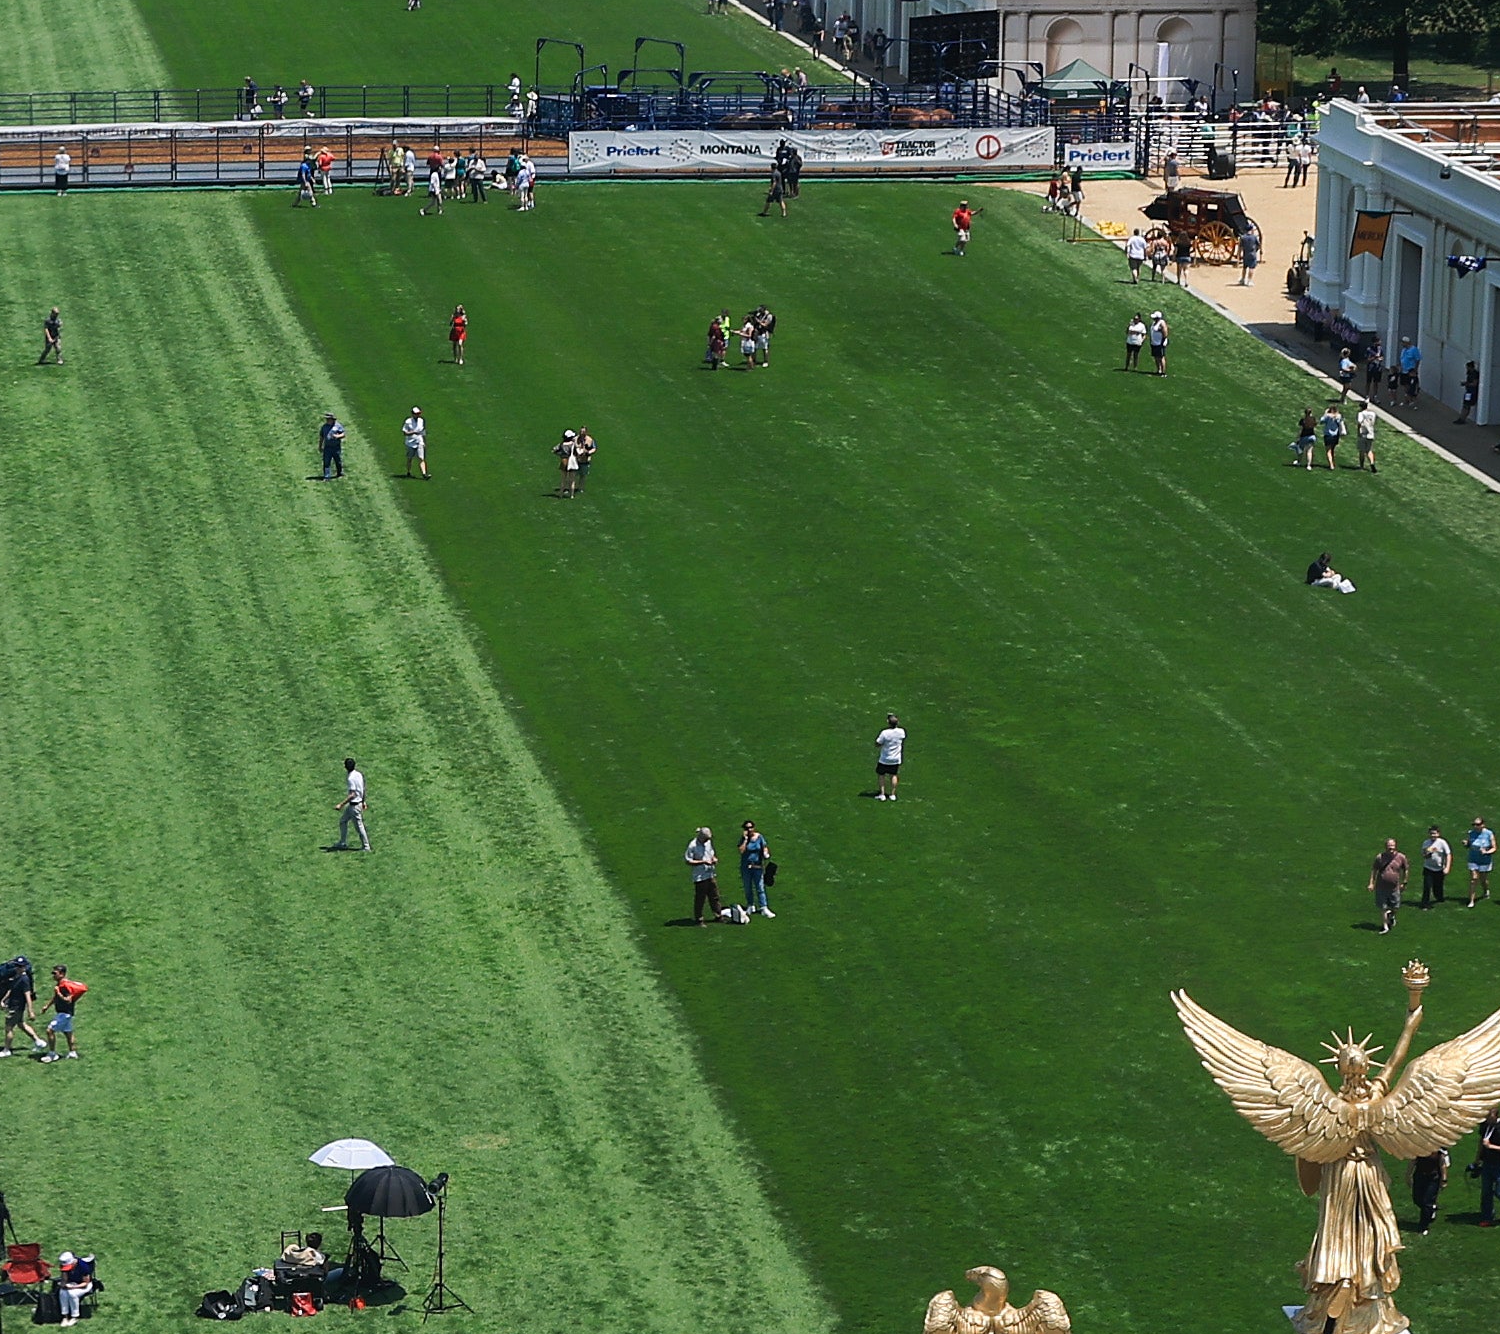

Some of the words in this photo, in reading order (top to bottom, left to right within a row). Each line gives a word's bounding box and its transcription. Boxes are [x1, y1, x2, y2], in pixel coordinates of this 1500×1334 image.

[896, 140, 936, 149] TRACTOR
[606, 145, 661, 157] Priefert
[700, 145, 762, 156] MONTANA
[895, 148, 925, 157] SUPPLY
[1068, 148, 1131, 163] Priefert
[1357, 230, 1384, 241] MERCH
